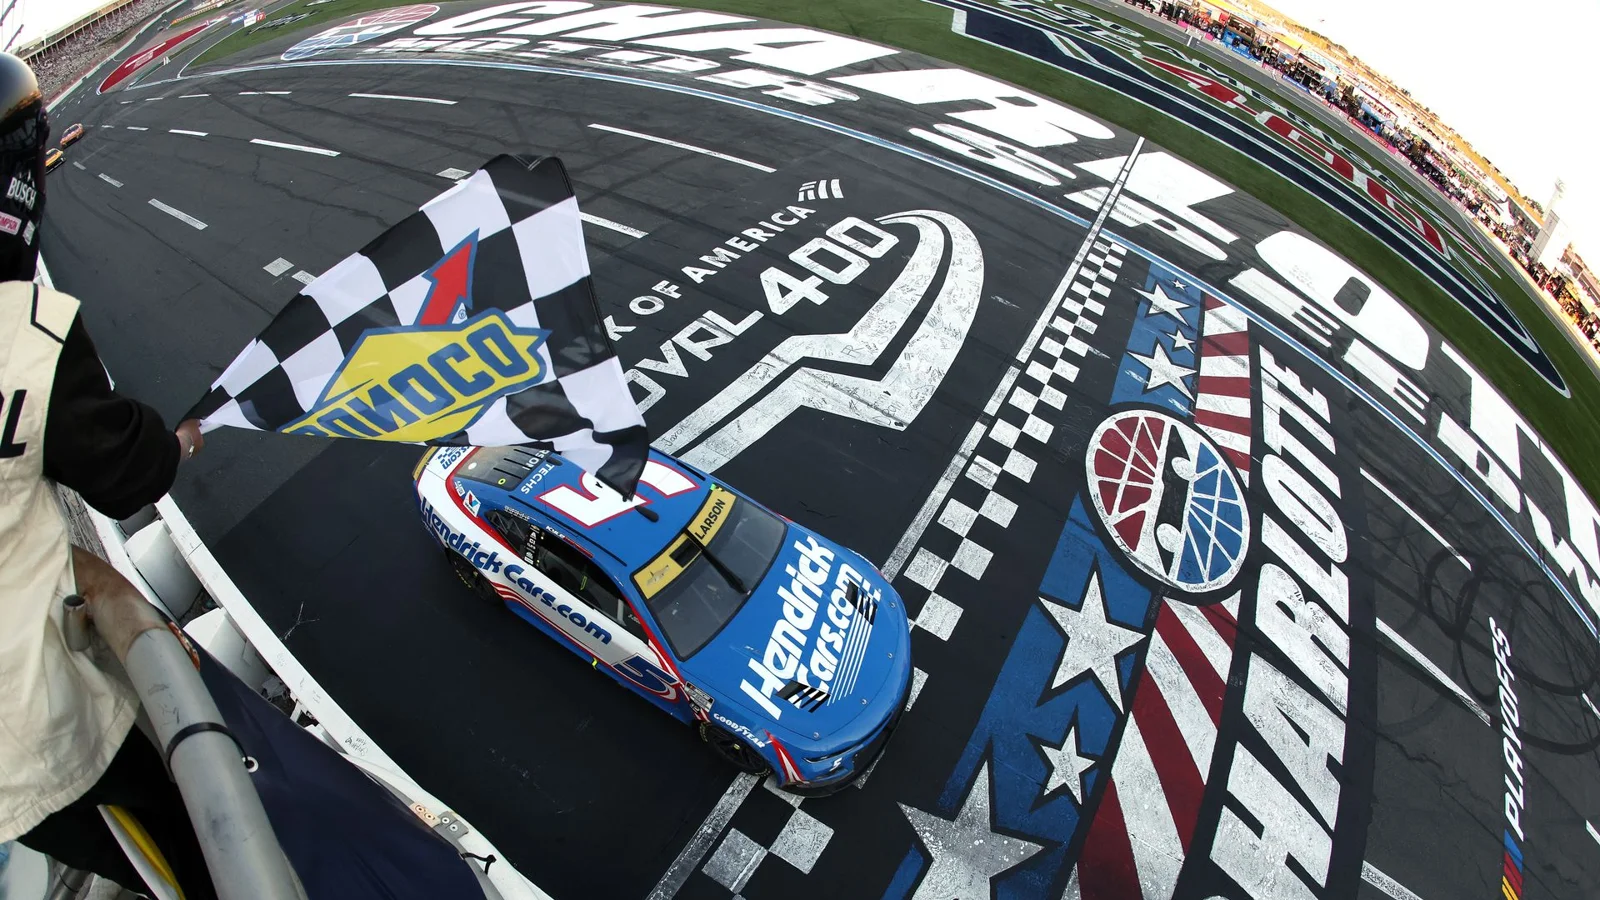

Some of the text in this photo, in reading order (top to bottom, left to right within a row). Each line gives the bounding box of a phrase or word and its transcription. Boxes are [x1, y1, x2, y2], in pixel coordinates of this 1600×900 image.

[0, 215, 18, 230] MPSON
[6, 176, 37, 210] BUSCH
[1135, 54, 1452, 260] 400
[623, 216, 899, 416] OVAL 400
[629, 280, 682, 315] OF
[681, 204, 816, 284] AMERICA
[520, 463, 555, 495] TECHS
[694, 498, 726, 541] LARSON
[420, 496, 503, 572] Hendrick
[503, 564, 612, 645] Cars.com
[740, 536, 835, 720] Hendrick
[796, 563, 864, 700] Cars.com
[1200, 344, 1351, 900] HARLOTTE
[713, 713, 765, 748] GOODYEAR
[1488, 616, 1524, 842] PLAYOFFS
